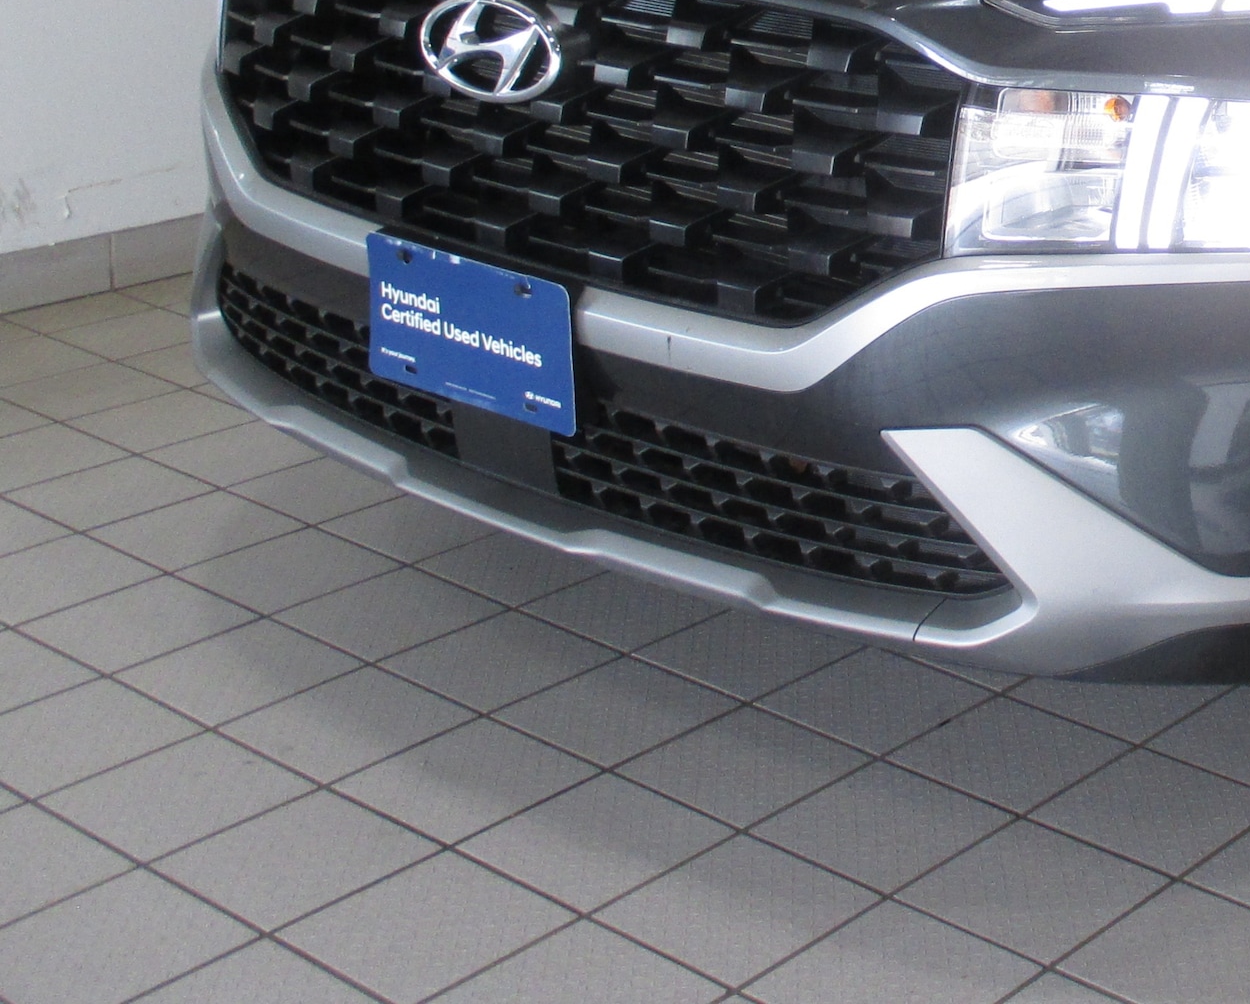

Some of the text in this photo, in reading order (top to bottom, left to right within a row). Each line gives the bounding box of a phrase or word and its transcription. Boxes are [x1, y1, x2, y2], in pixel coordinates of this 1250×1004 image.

[381, 281, 441, 314] Hyundai
[381, 303, 543, 368] Certified Used Vehicles
